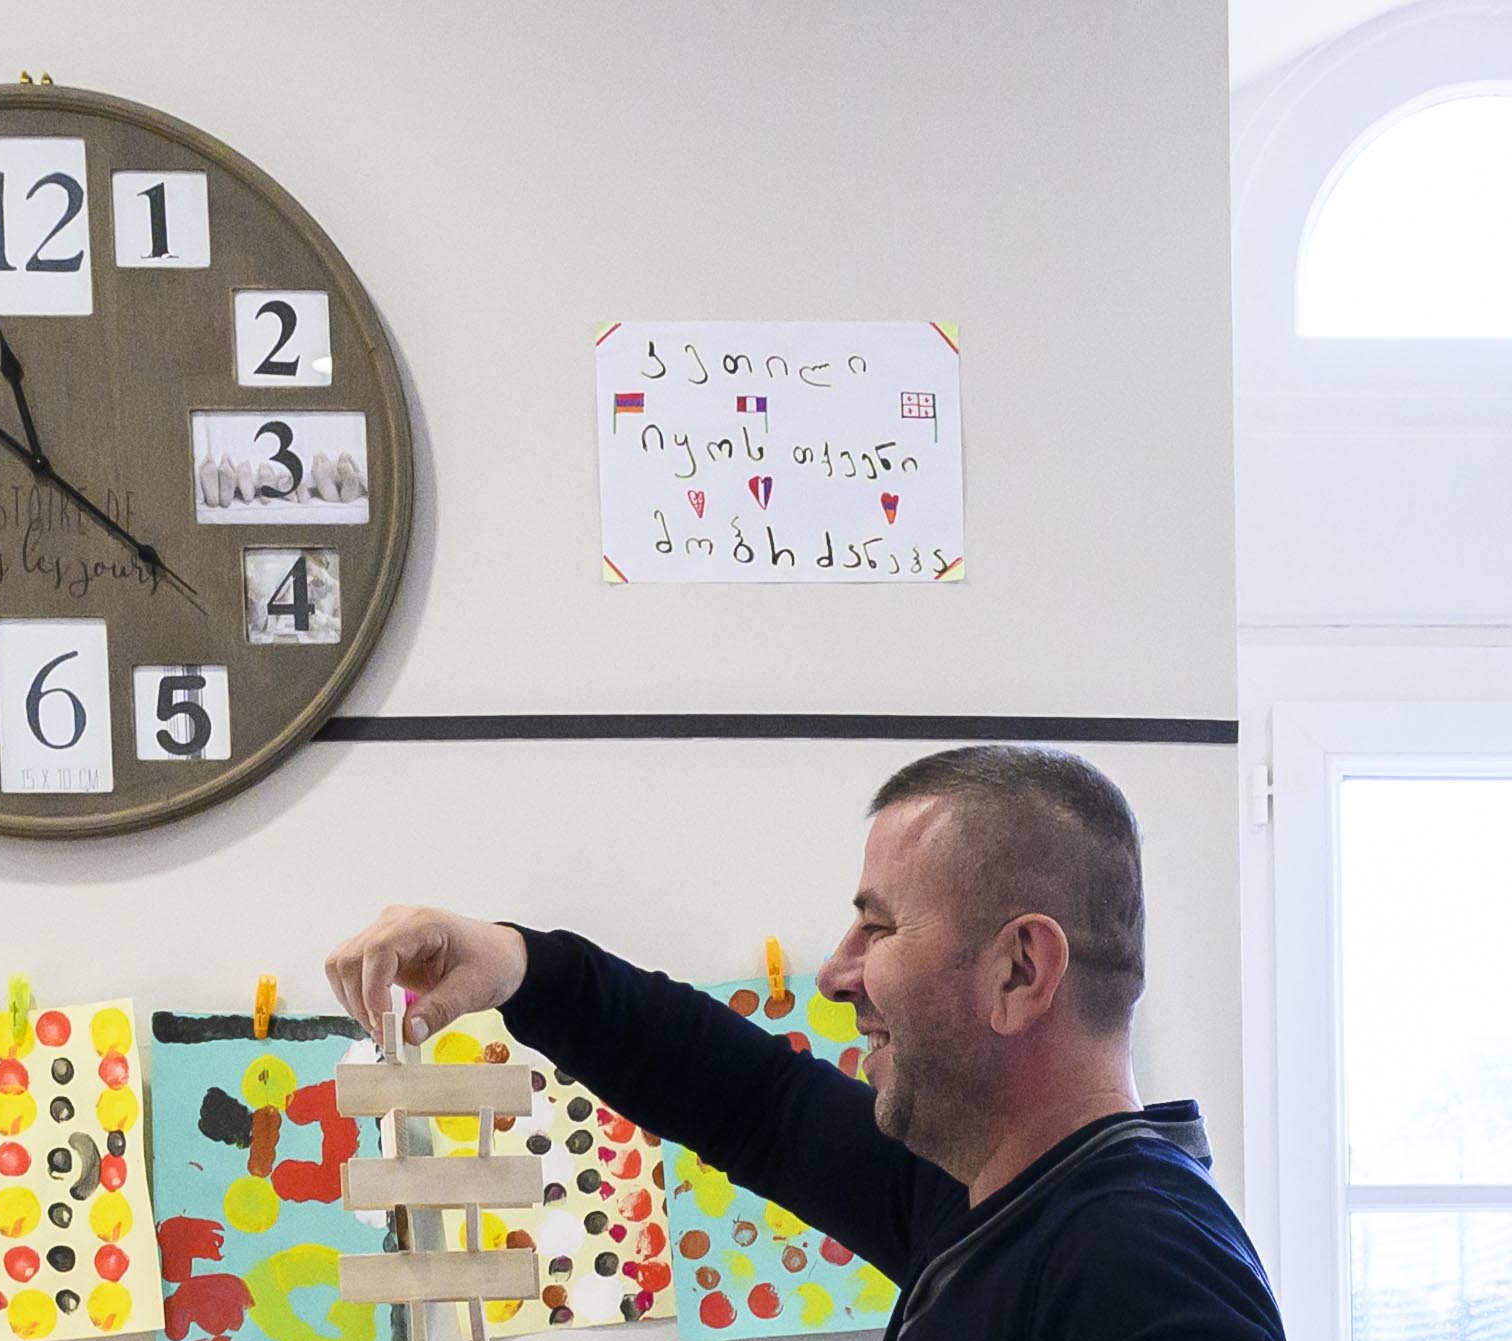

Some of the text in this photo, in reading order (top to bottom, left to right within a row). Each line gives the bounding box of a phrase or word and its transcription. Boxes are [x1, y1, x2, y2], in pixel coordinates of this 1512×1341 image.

[136, 182, 181, 259] 1
[253, 300, 301, 377] 2
[253, 421, 304, 499] 3
[267, 555, 316, 632] 4
[26, 651, 88, 751] 6
[155, 676, 212, 756] 5
